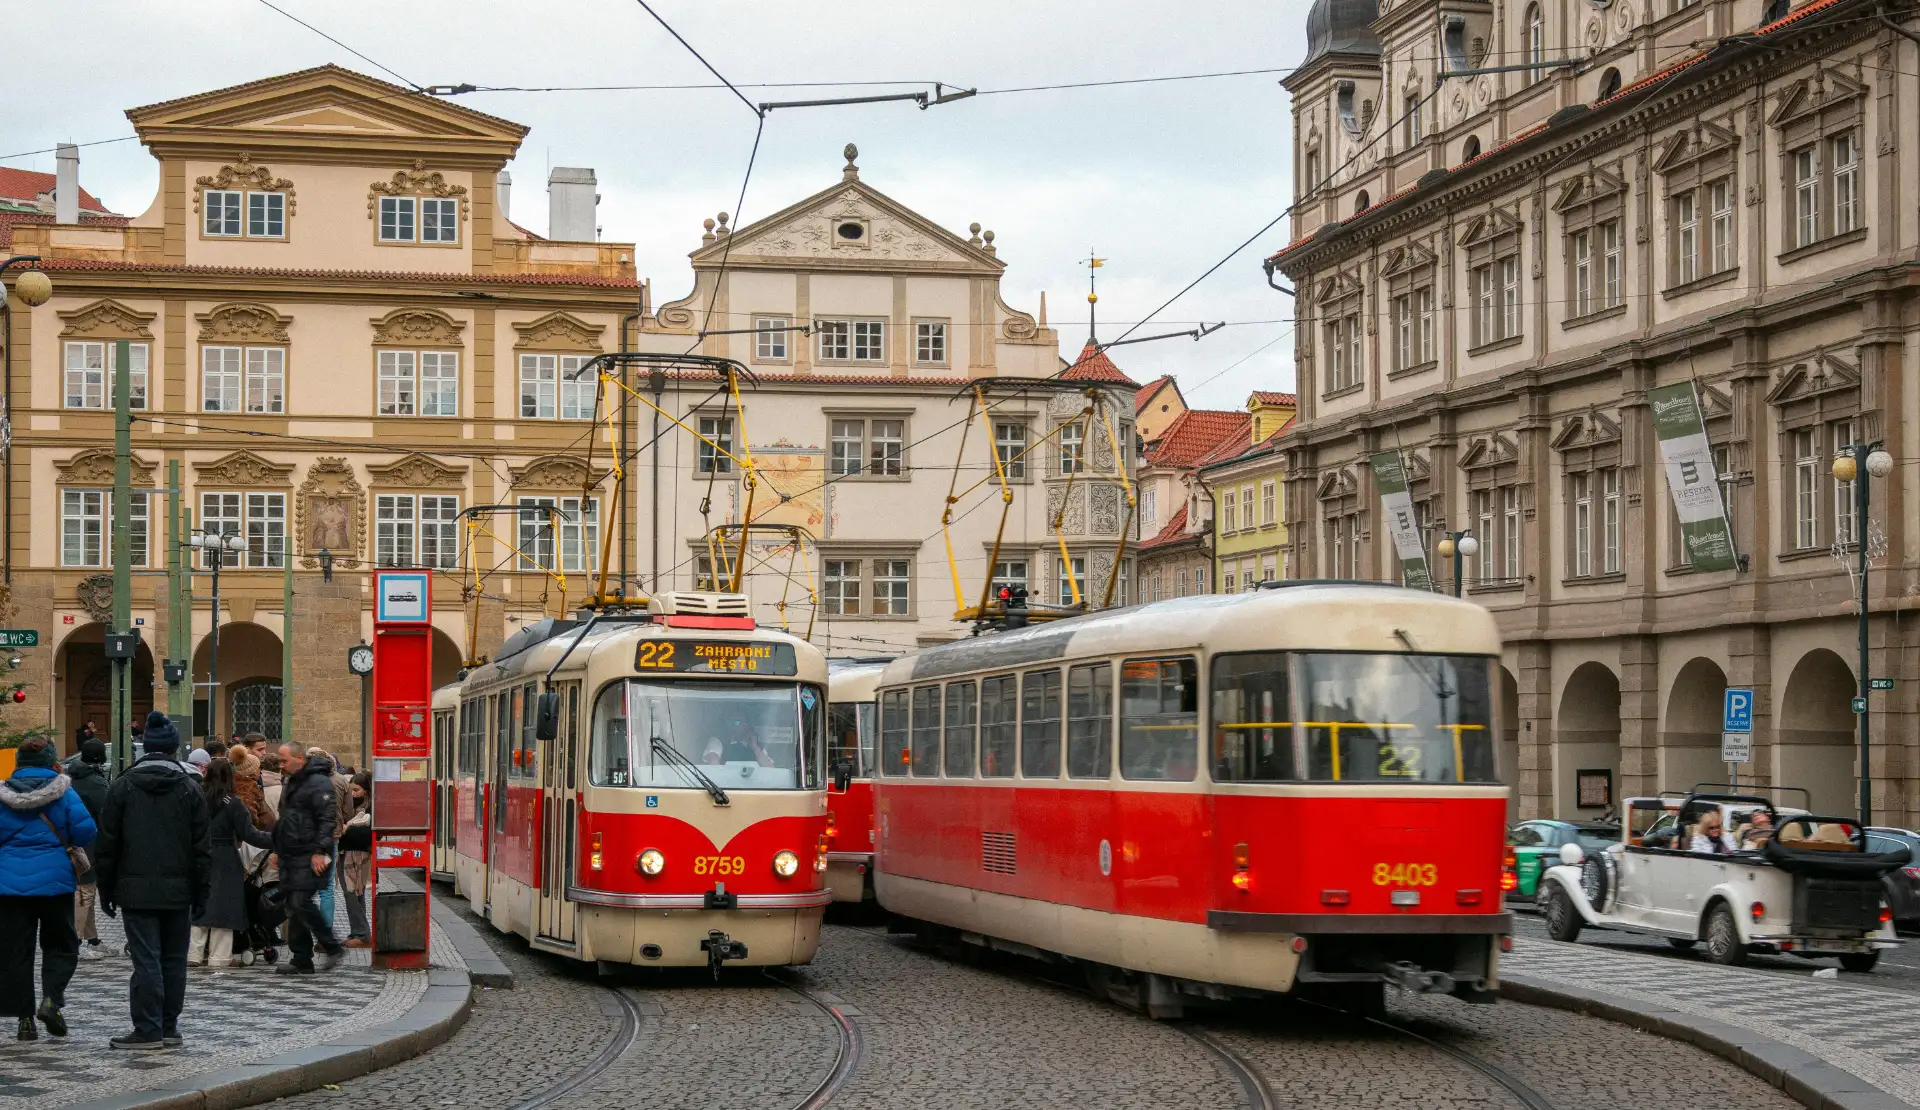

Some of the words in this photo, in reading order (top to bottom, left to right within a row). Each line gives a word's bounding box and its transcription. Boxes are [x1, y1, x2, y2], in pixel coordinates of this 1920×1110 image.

[1677, 486, 1712, 499] BESEDA
[10, 634, 24, 644] WC
[639, 641, 675, 668] 22
[695, 645, 772, 658] ZAHRADNÍ
[708, 657, 757, 670] MĚSTO
[1879, 680, 1887, 688] WC
[1731, 695, 1747, 717] P
[1379, 745, 1420, 775] 22
[694, 856, 745, 875] 8759
[1372, 862, 1438, 886] 8403
